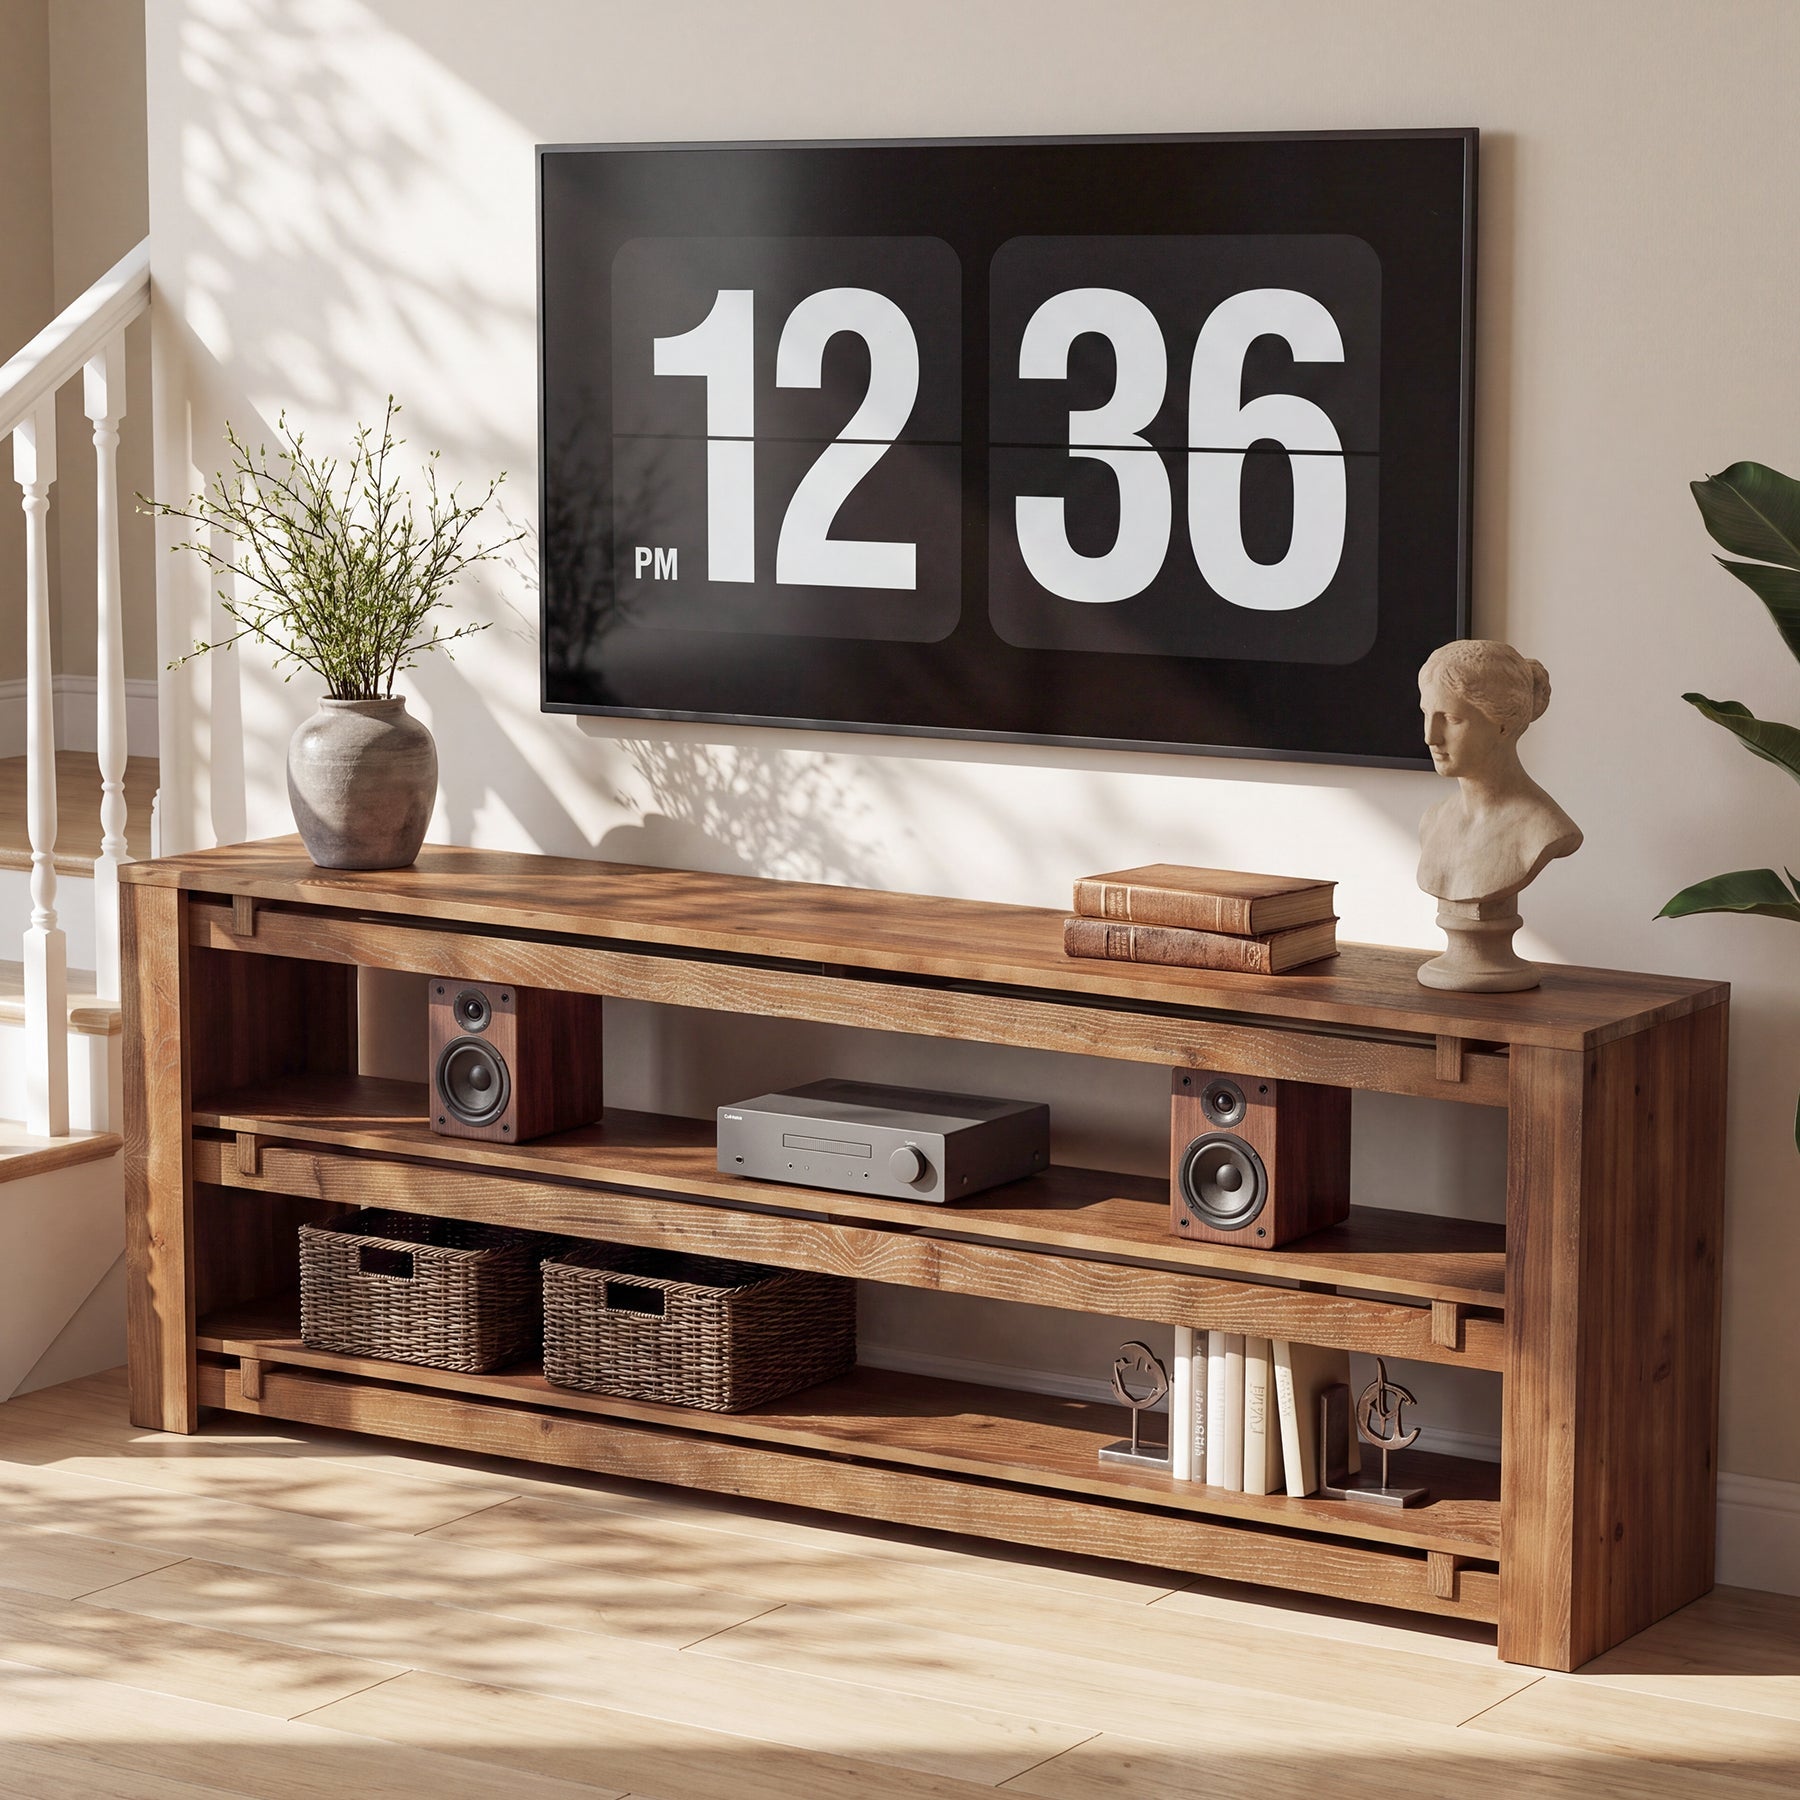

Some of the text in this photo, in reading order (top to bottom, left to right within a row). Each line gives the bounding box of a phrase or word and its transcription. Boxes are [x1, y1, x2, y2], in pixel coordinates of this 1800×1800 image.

[653, 288, 1347, 611] 12 36
[635, 547, 679, 581] PM
